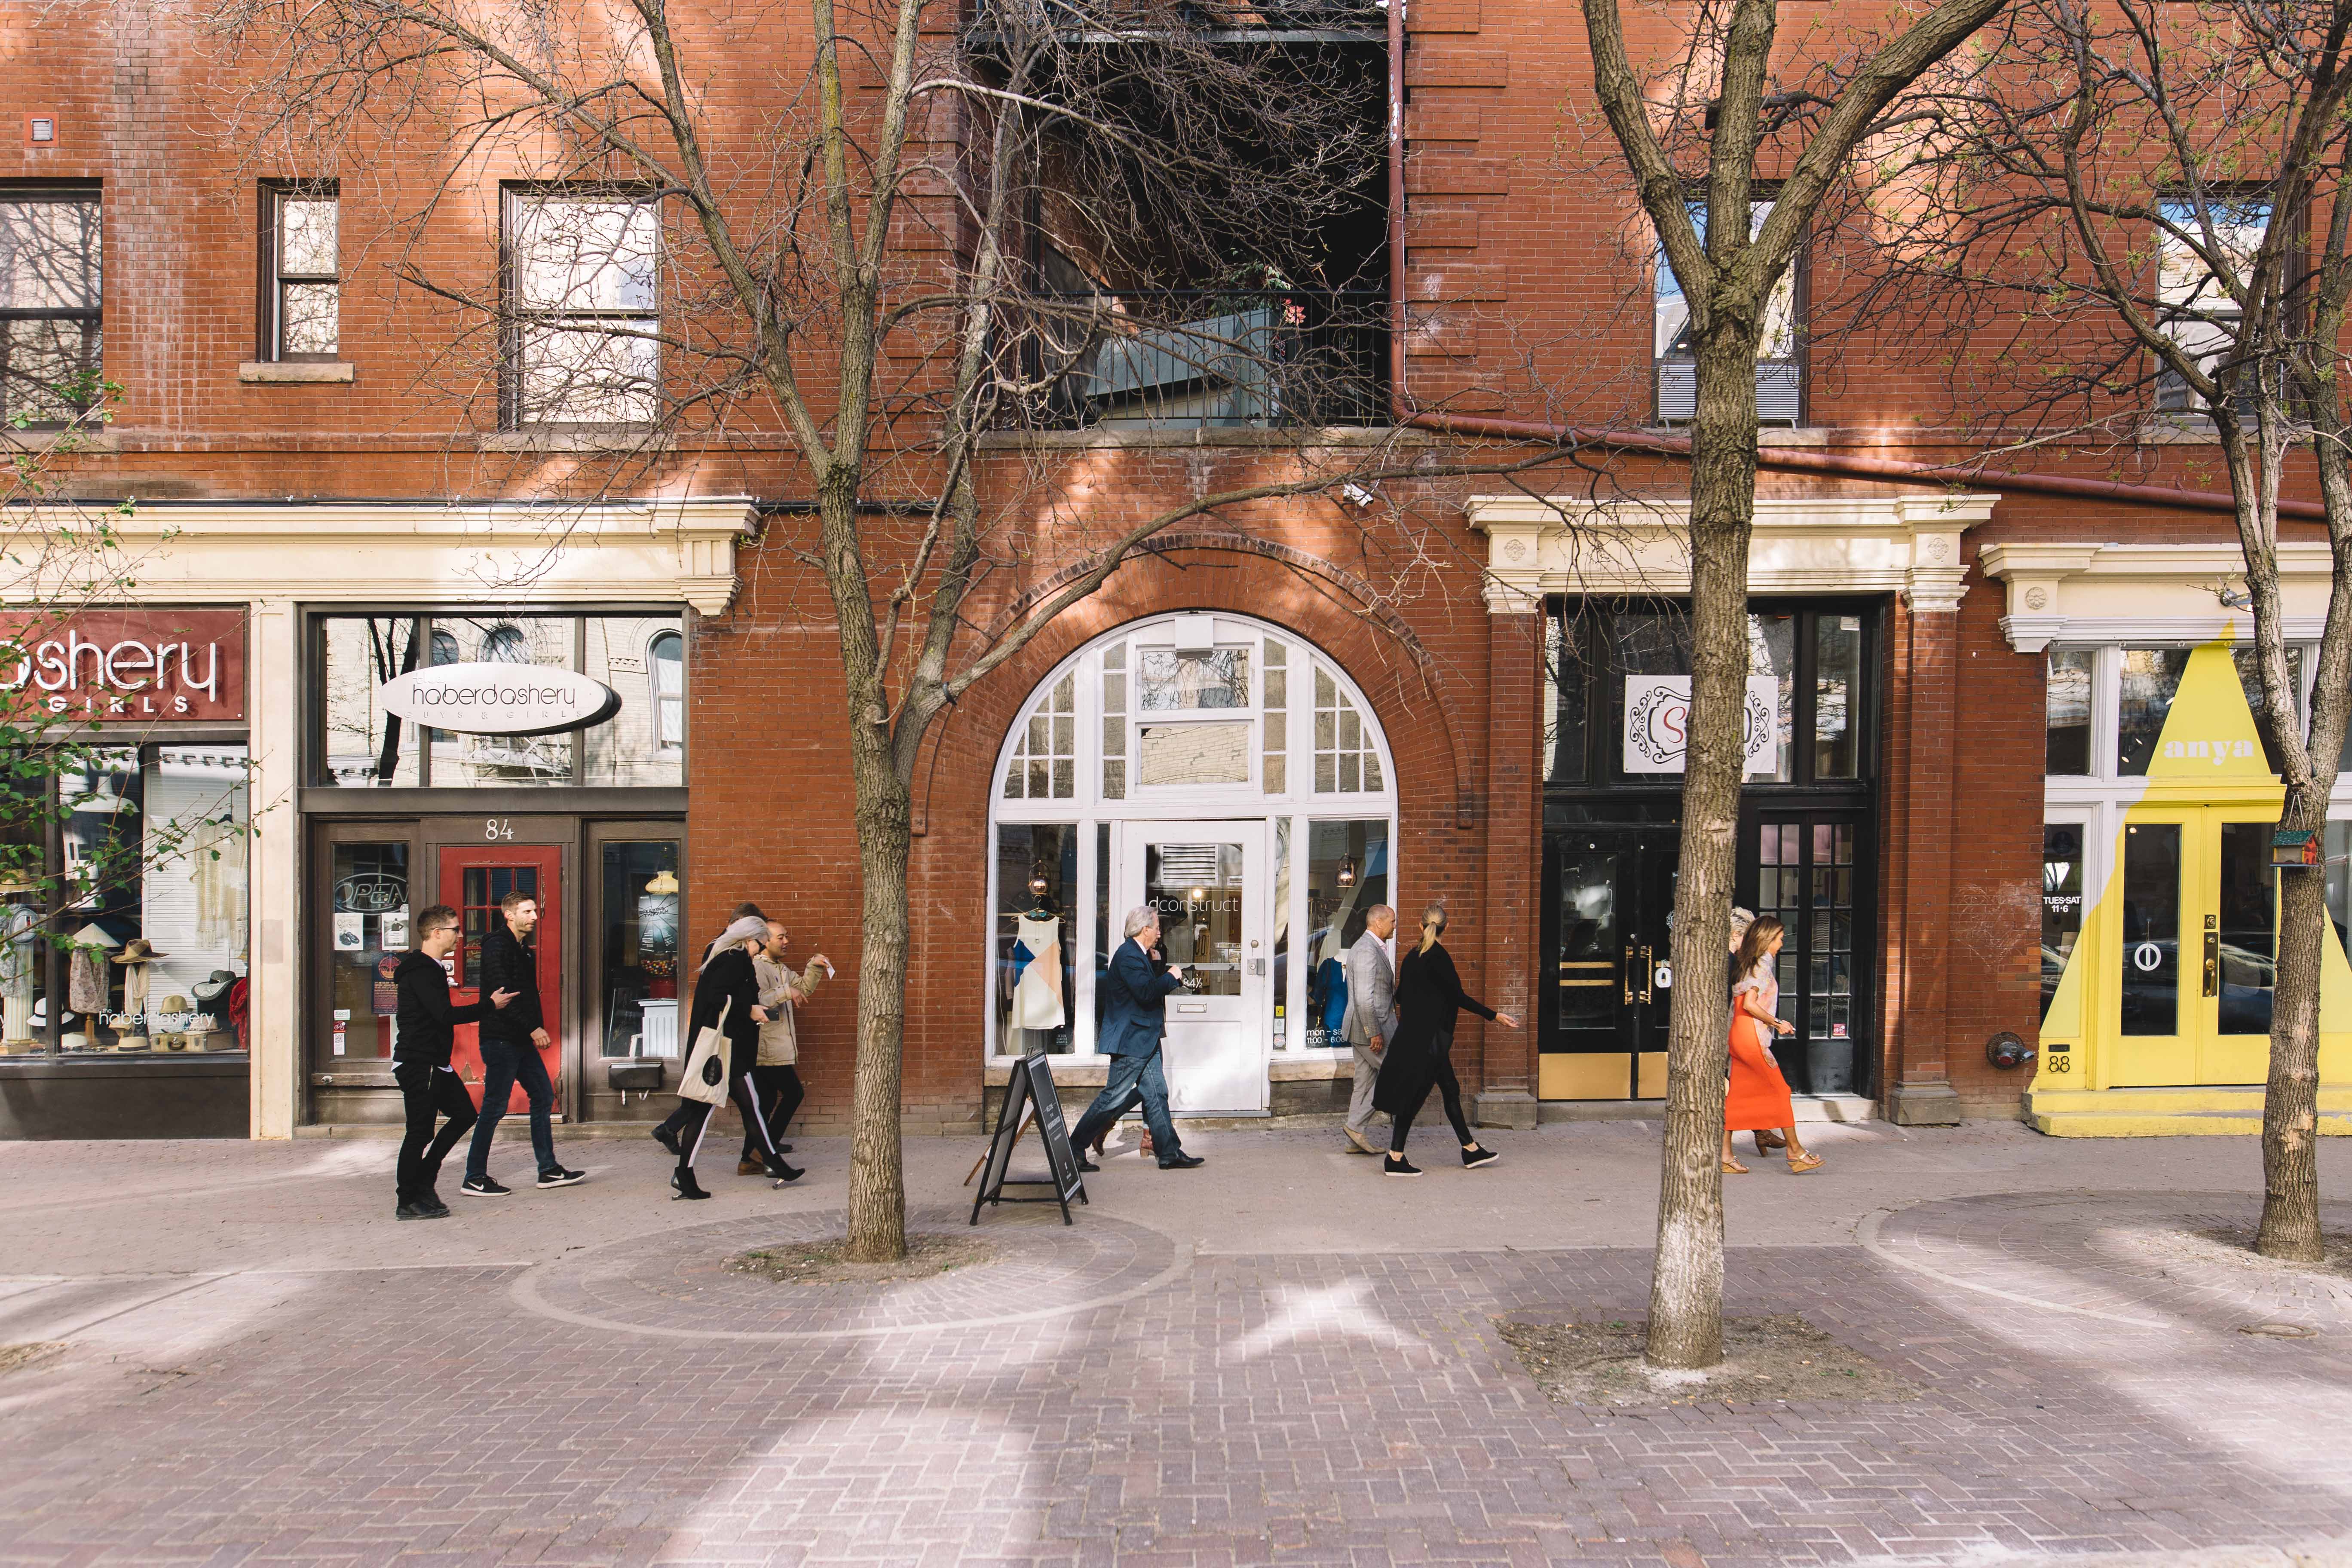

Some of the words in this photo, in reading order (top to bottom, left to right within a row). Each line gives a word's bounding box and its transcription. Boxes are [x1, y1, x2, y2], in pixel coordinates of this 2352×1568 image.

[48, 696, 187, 713] GIRLS
[413, 684, 575, 709] haberdashery
[2164, 740, 2255, 766] anya
[485, 818, 514, 840] 84
[335, 882, 409, 903] OPEN
[1148, 896, 1238, 912] dconstruct
[99, 1010, 215, 1027] haberdashery
[2049, 1055, 2070, 1073] 88
